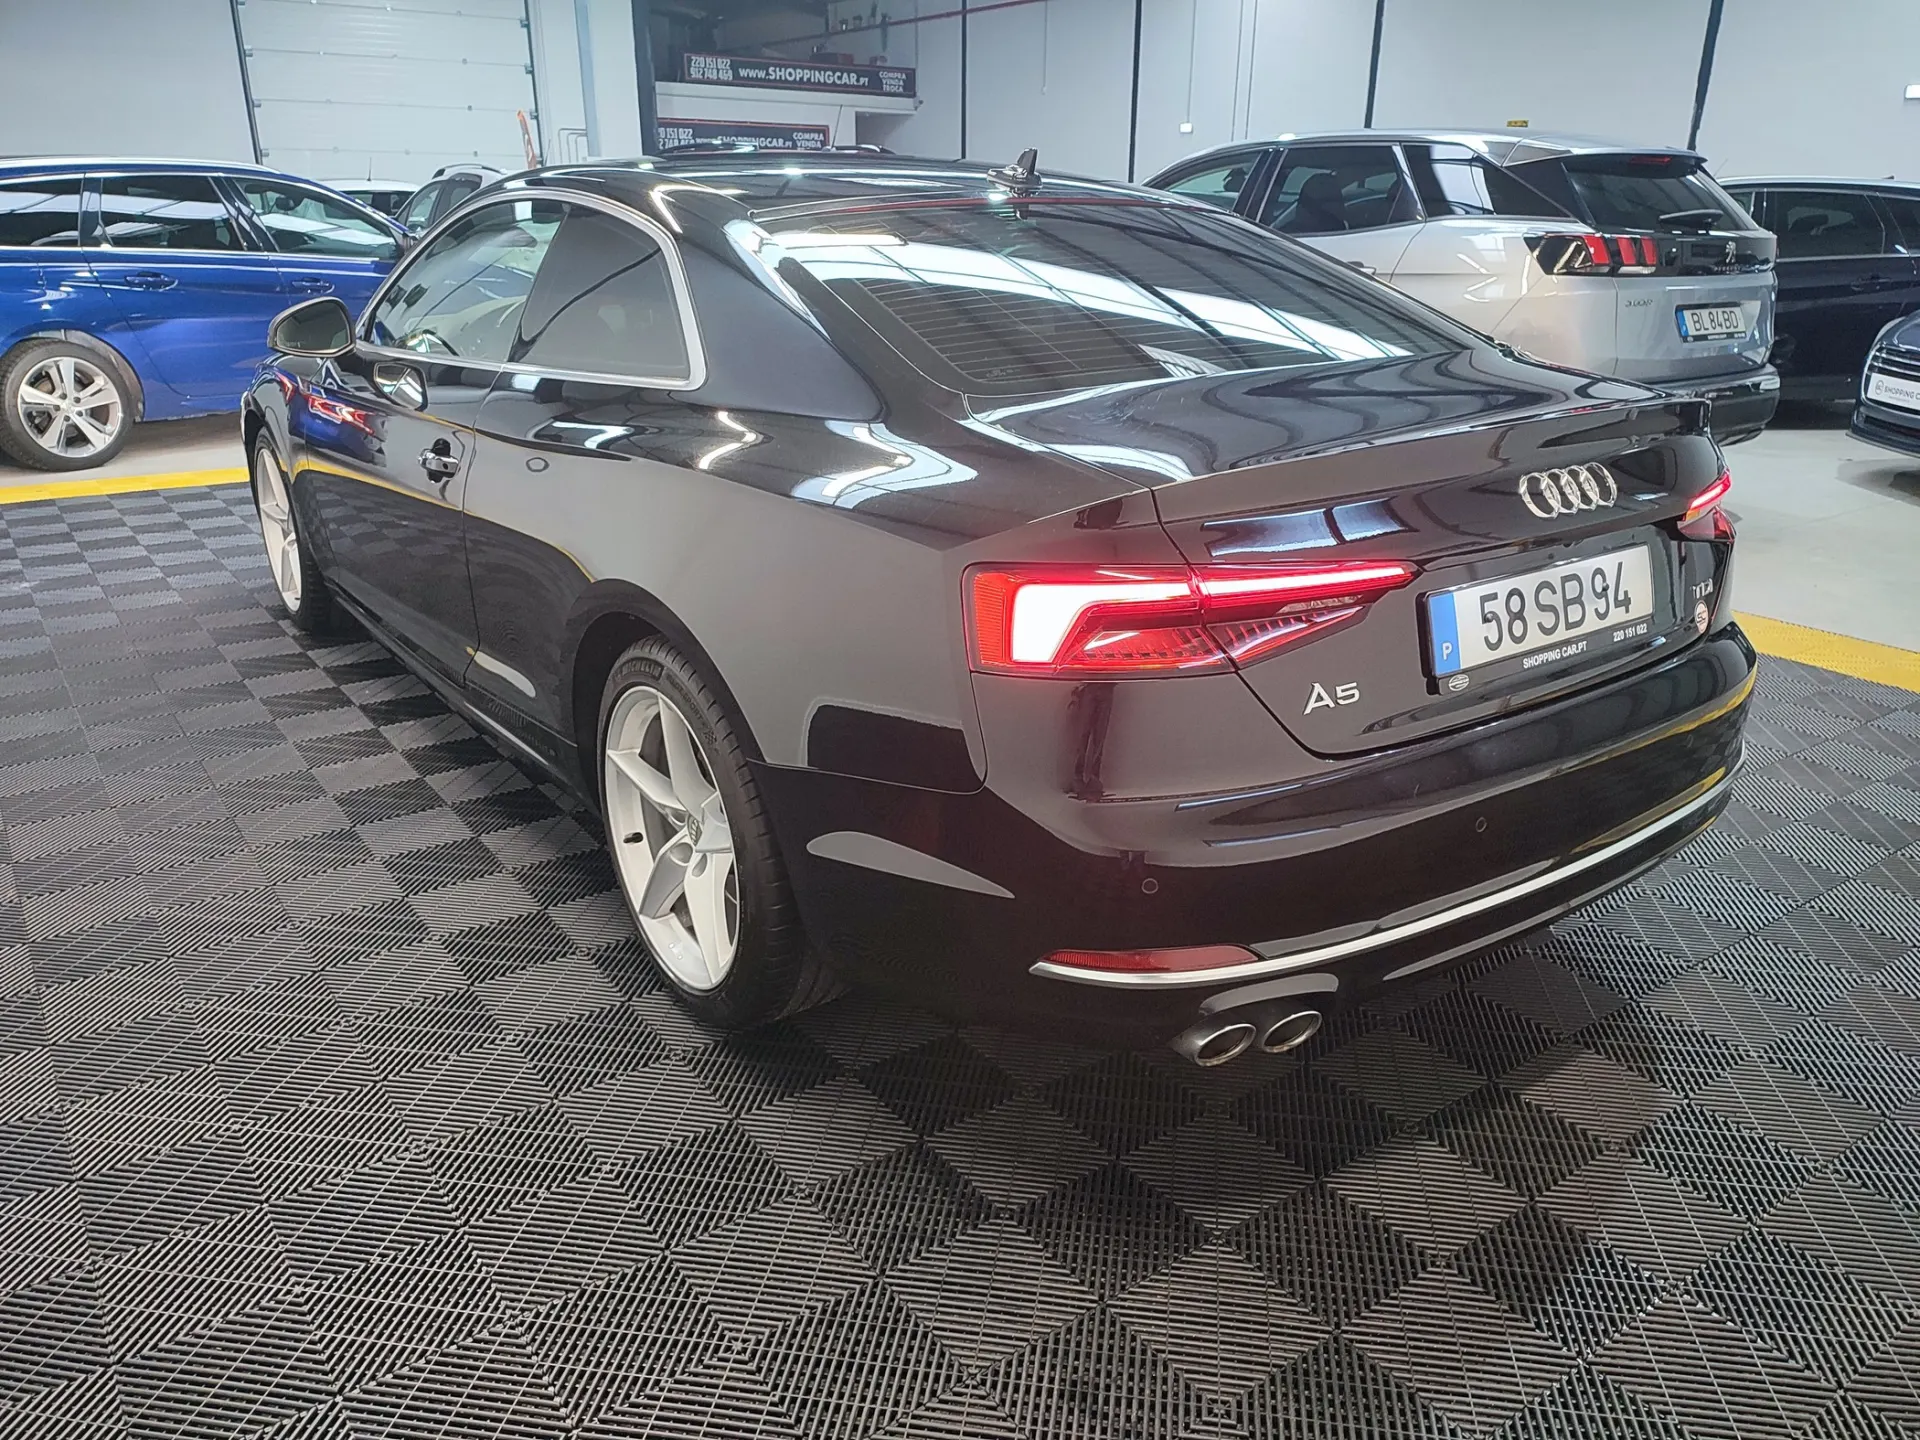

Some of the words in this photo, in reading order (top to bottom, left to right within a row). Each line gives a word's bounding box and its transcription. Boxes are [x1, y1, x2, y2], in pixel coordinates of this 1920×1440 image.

[879, 71, 906, 79] COMPRA
[792, 132, 824, 141] COMPRA
[795, 140, 822, 148] VENDA
[1613, 630, 1625, 642] 220
[1625, 626, 1636, 638] 151
[1636, 623, 1647, 635] 022
[1442, 642, 1452, 660] P
[1523, 649, 1560, 668] SHOPPING
[1303, 682, 1360, 715] A5
